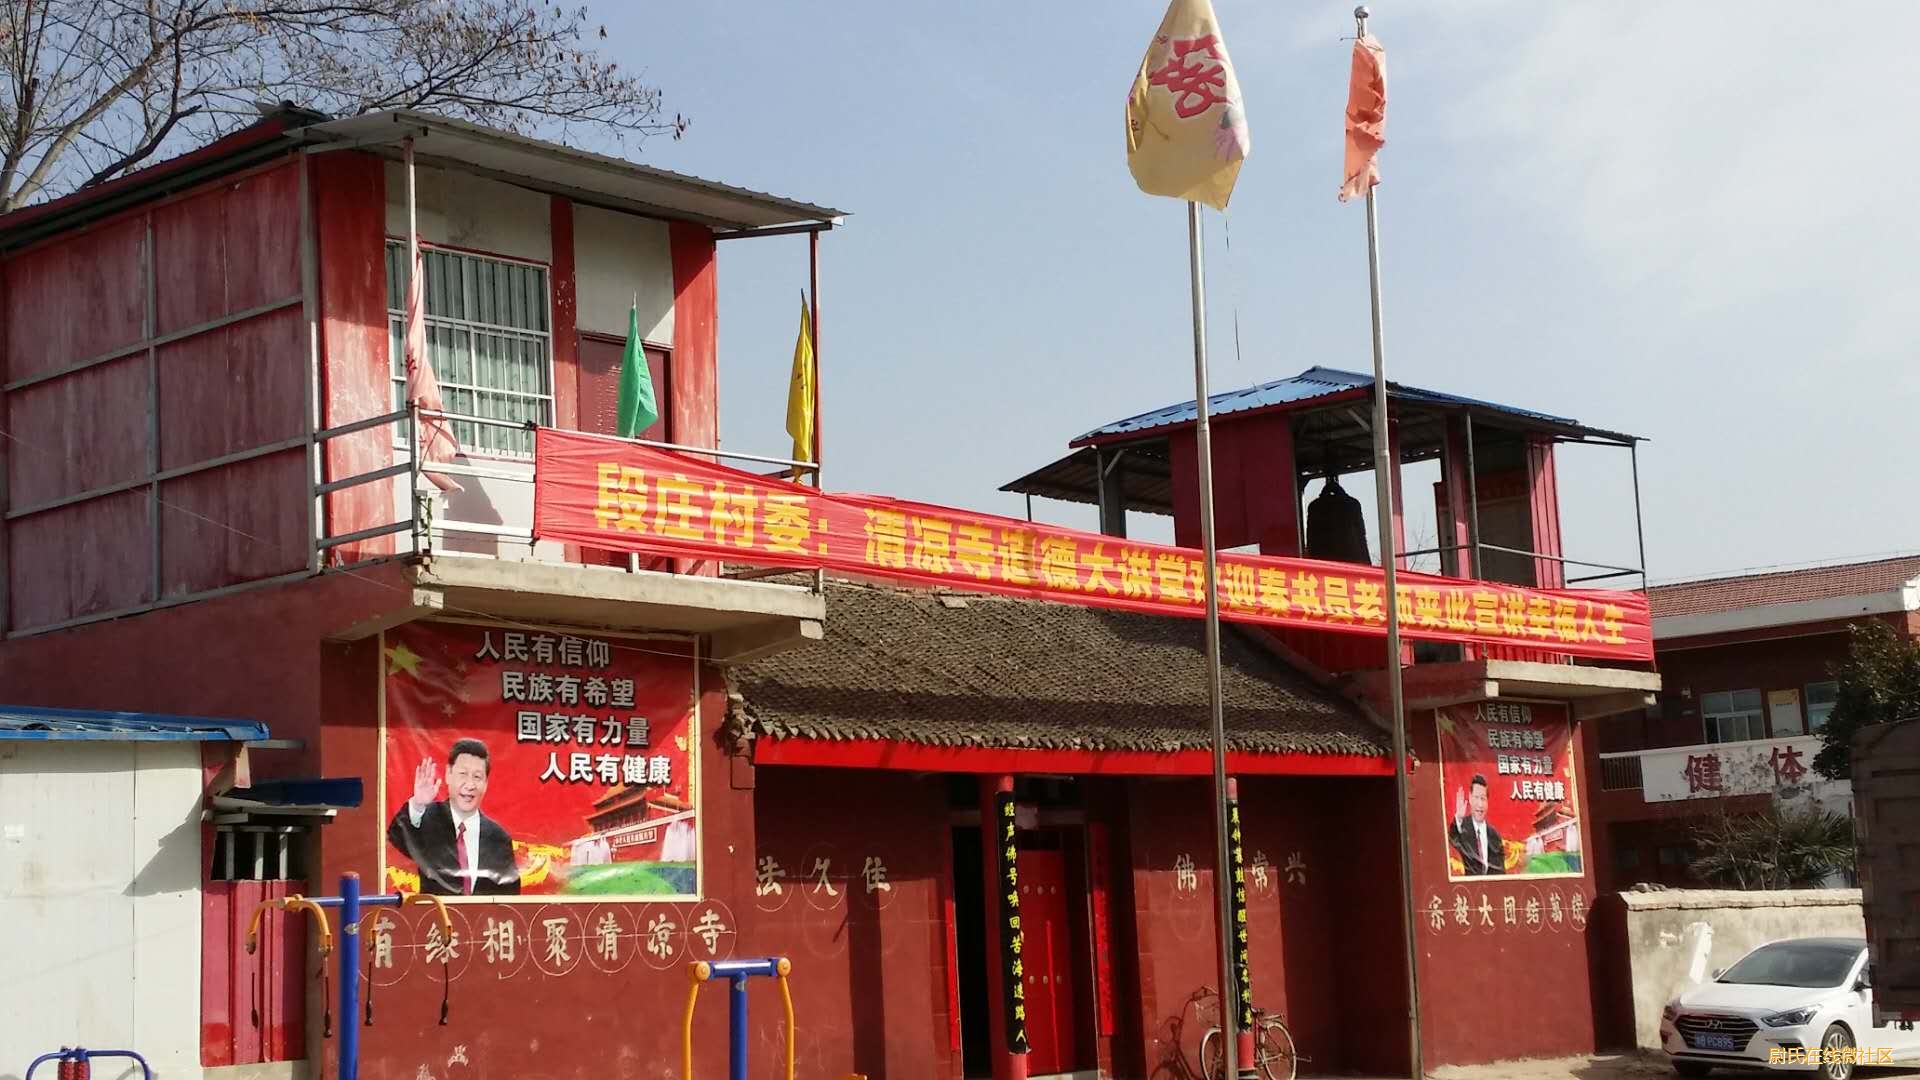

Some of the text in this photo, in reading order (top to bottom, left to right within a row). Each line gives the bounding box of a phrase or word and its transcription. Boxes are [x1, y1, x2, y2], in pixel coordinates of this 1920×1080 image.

[475, 632, 611, 669] 人民有信仰
[501, 671, 636, 708] 民族有希望
[1474, 703, 1533, 724] 人民有信仰
[516, 711, 652, 747] 国家有力量
[1488, 729, 1545, 751] 民族有希望
[539, 753, 672, 785] 人民有健康
[1497, 754, 1555, 777] 国家有力量
[1510, 780, 1566, 802] 人民有健康
